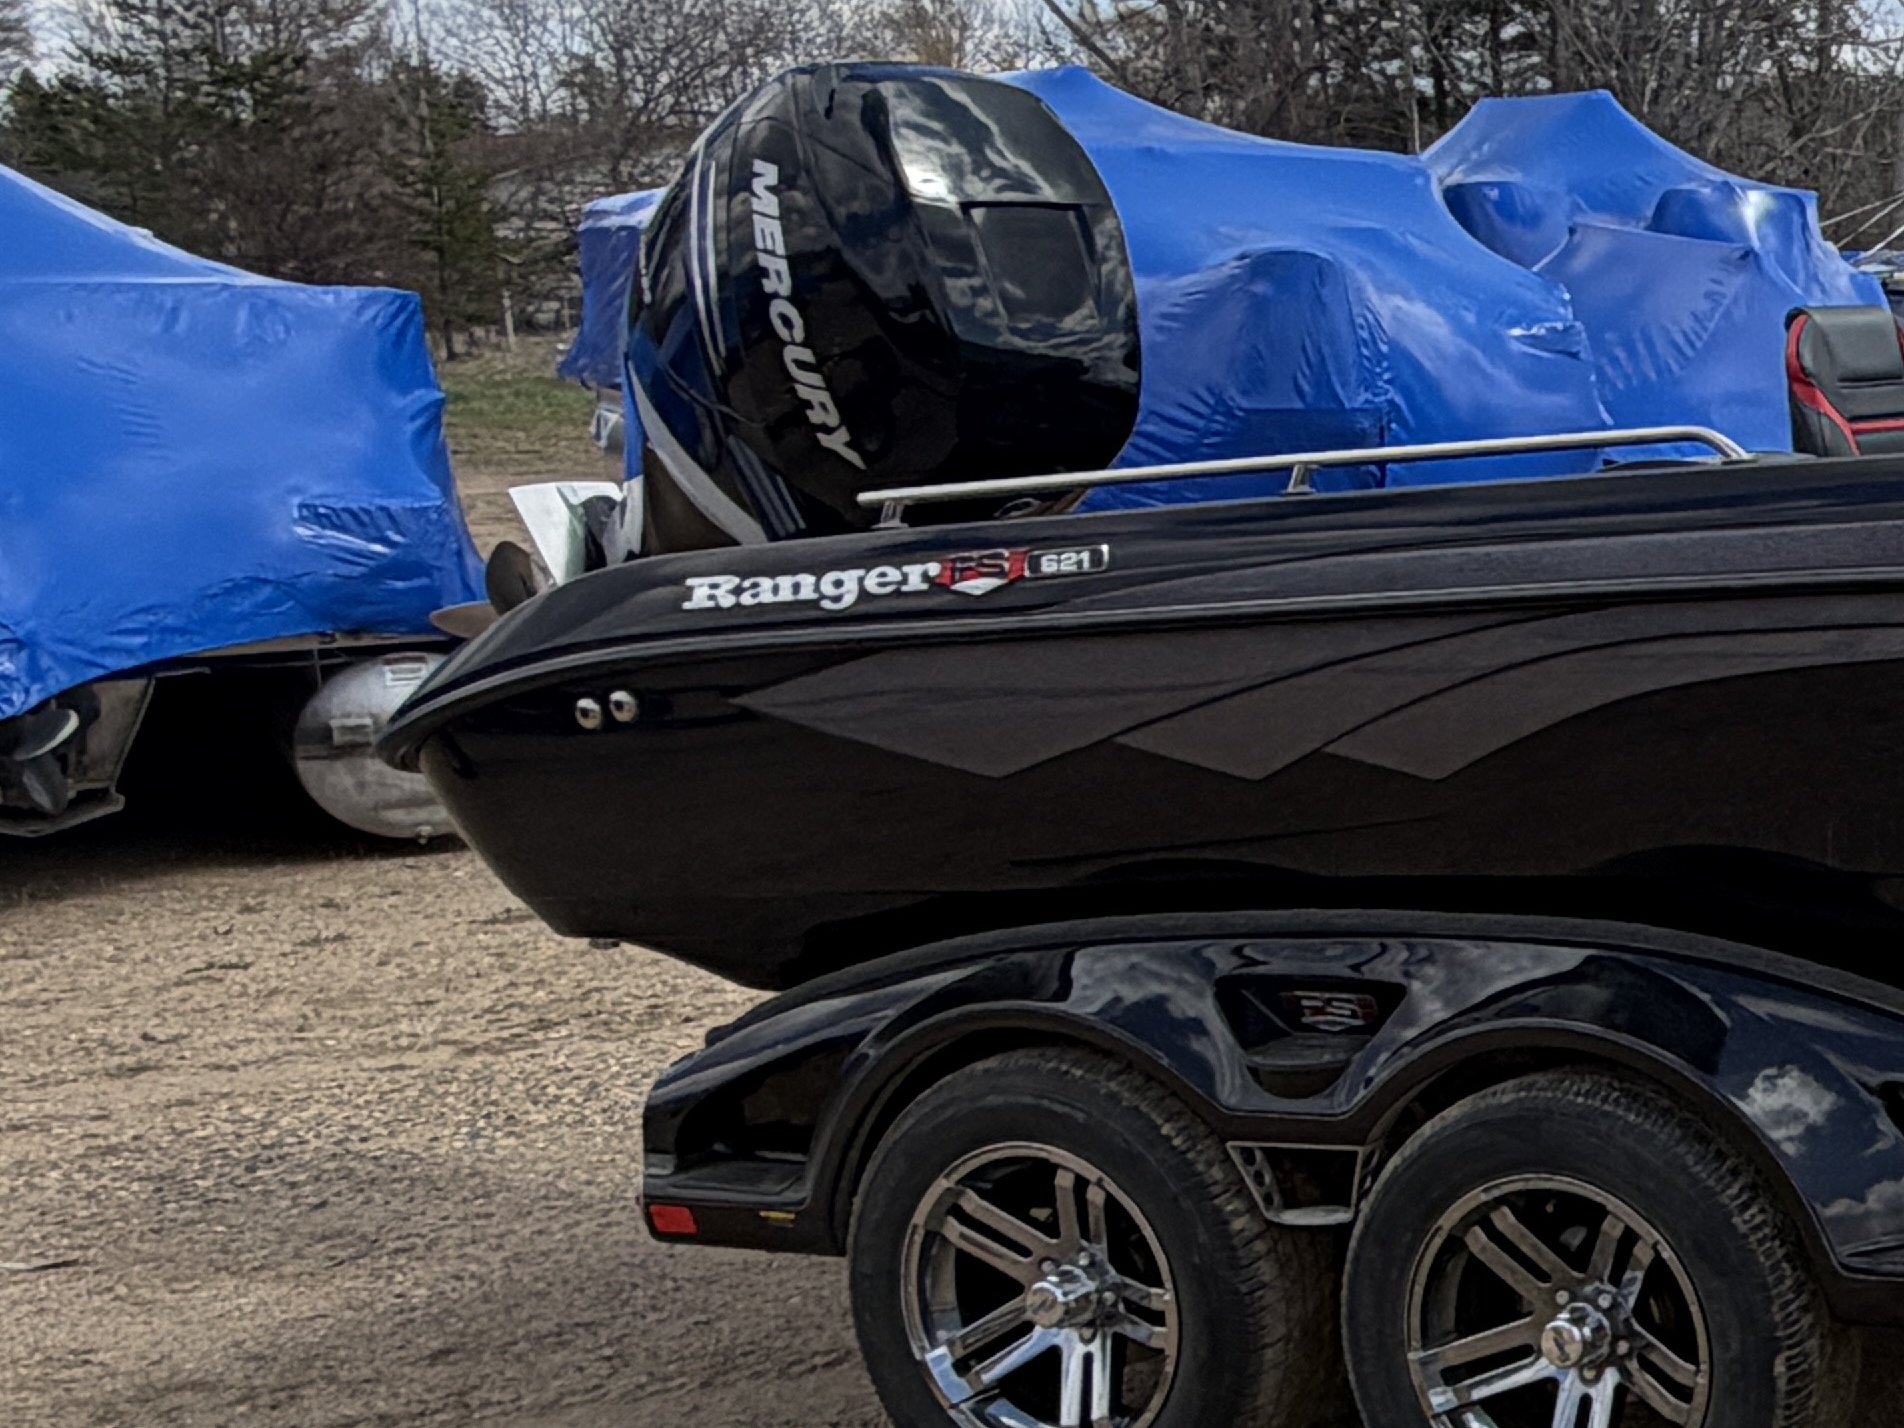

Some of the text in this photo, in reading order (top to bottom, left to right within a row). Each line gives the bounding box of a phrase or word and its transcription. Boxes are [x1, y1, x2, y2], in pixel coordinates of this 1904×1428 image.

[751, 157, 867, 470] MERCURY
[681, 561, 941, 610] Ranger
[1040, 550, 1091, 573] 621
